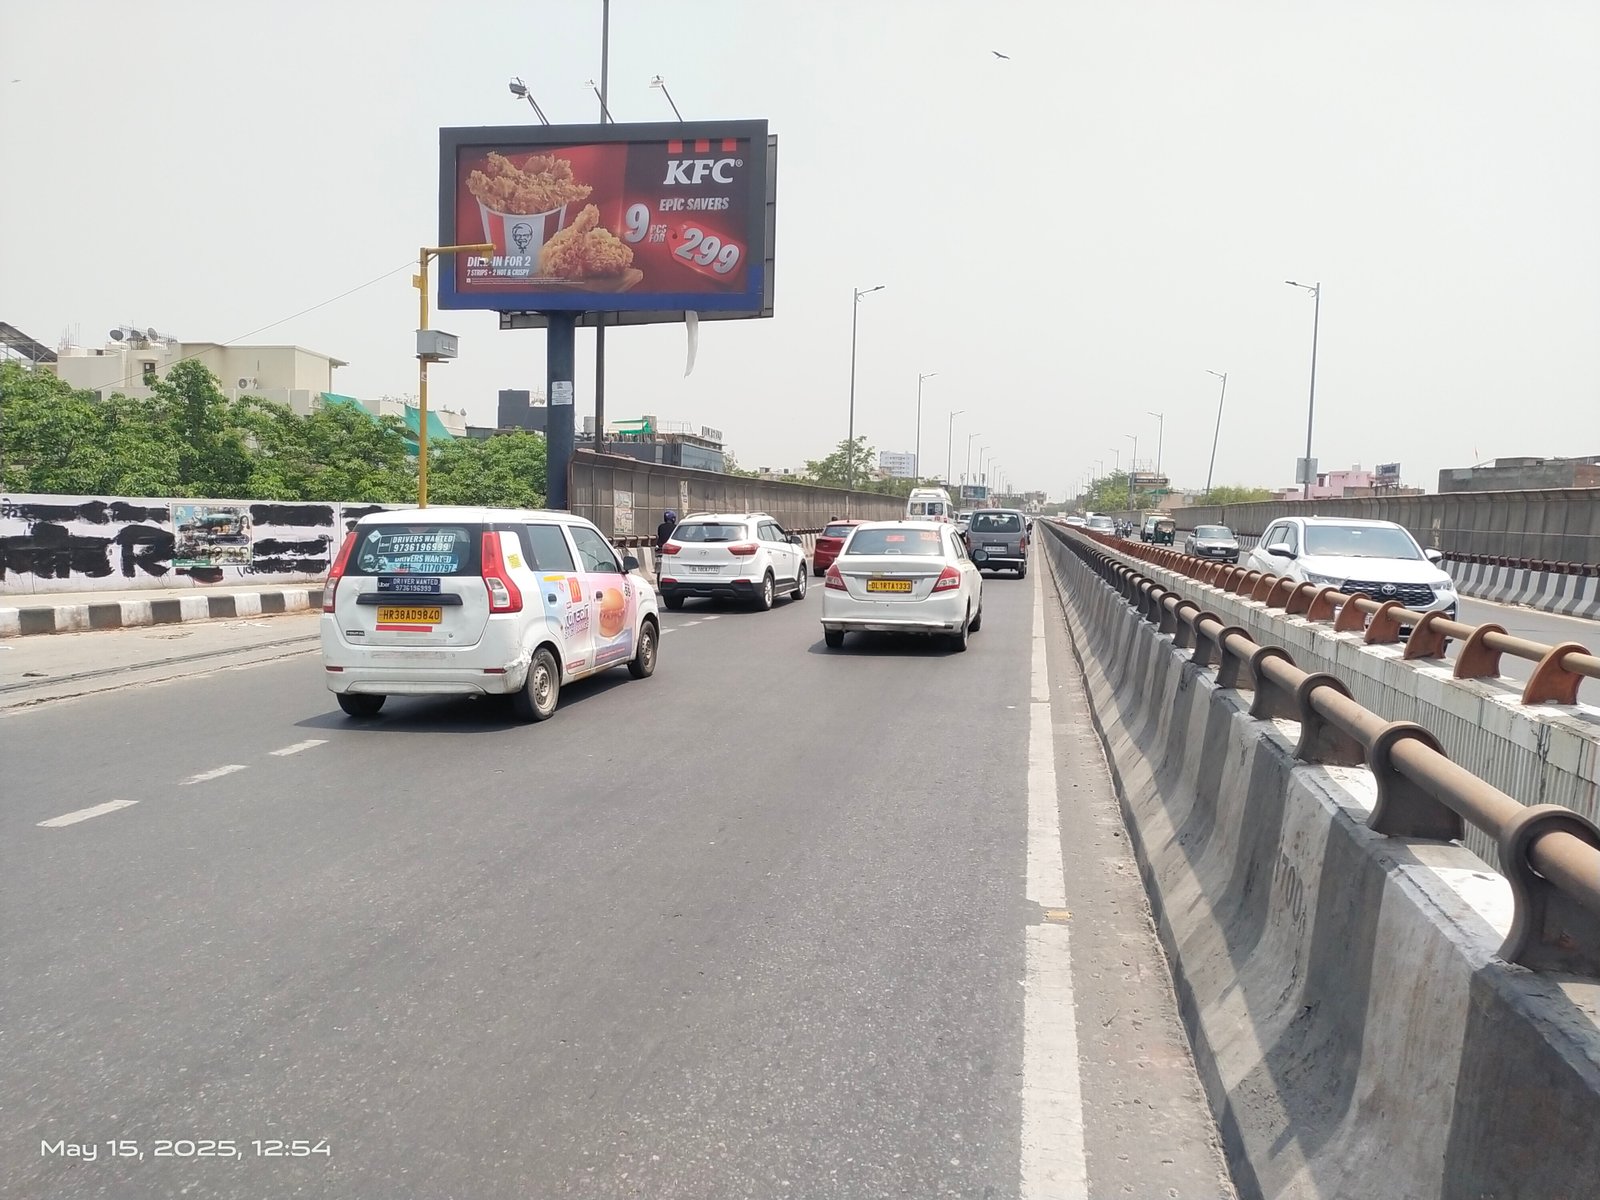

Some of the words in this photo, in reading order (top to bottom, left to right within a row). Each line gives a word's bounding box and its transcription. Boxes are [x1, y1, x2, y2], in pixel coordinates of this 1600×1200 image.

[659, 198, 685, 211] EPIC
[686, 196, 730, 211] SAVERS
[624, 203, 650, 243] 9
[650, 224, 668, 234] PCS
[648, 232, 666, 243] FOR
[674, 227, 740, 274] 299
[505, 255, 522, 267] FOR
[525, 255, 531, 267] 2
[392, 535, 423, 543] DRIVERS
[424, 535, 453, 543] WANTED
[393, 542, 449, 552] 9736196999
[416, 578, 439, 586] WANTED
[871, 581, 911, 589] DL1RTA1333
[383, 610, 440, 620] HR38AD9840
